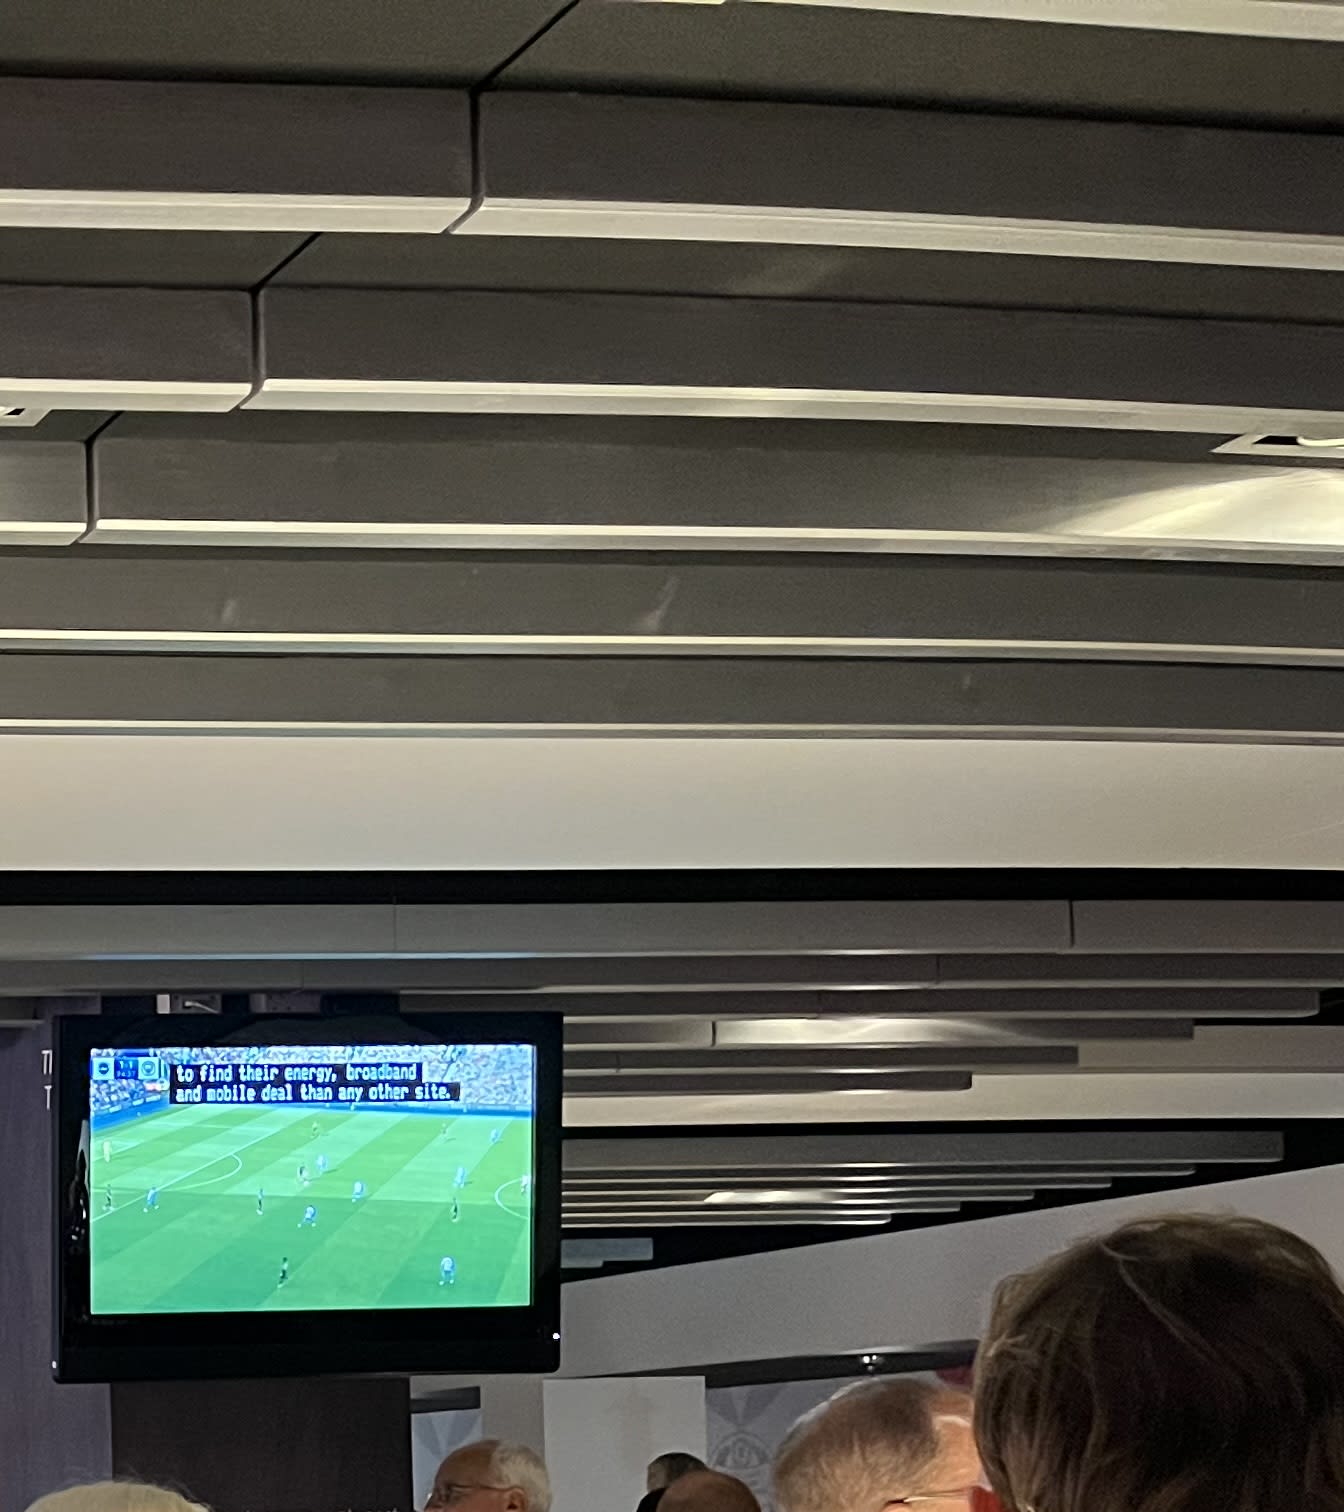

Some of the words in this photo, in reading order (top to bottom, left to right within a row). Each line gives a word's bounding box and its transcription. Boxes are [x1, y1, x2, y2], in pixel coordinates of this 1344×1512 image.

[176, 1064, 194, 1082] to
[200, 1064, 232, 1082] find
[238, 1064, 279, 1082] their
[284, 1065, 337, 1083] energy,
[345, 1063, 417, 1081] broadband
[175, 1085, 202, 1102] and
[206, 1084, 256, 1102] mobile
[261, 1083, 292, 1101] deal
[300, 1083, 333, 1101] than
[338, 1086, 363, 1102] any
[368, 1083, 409, 1100] other
[414, 1083, 451, 1100] site.
